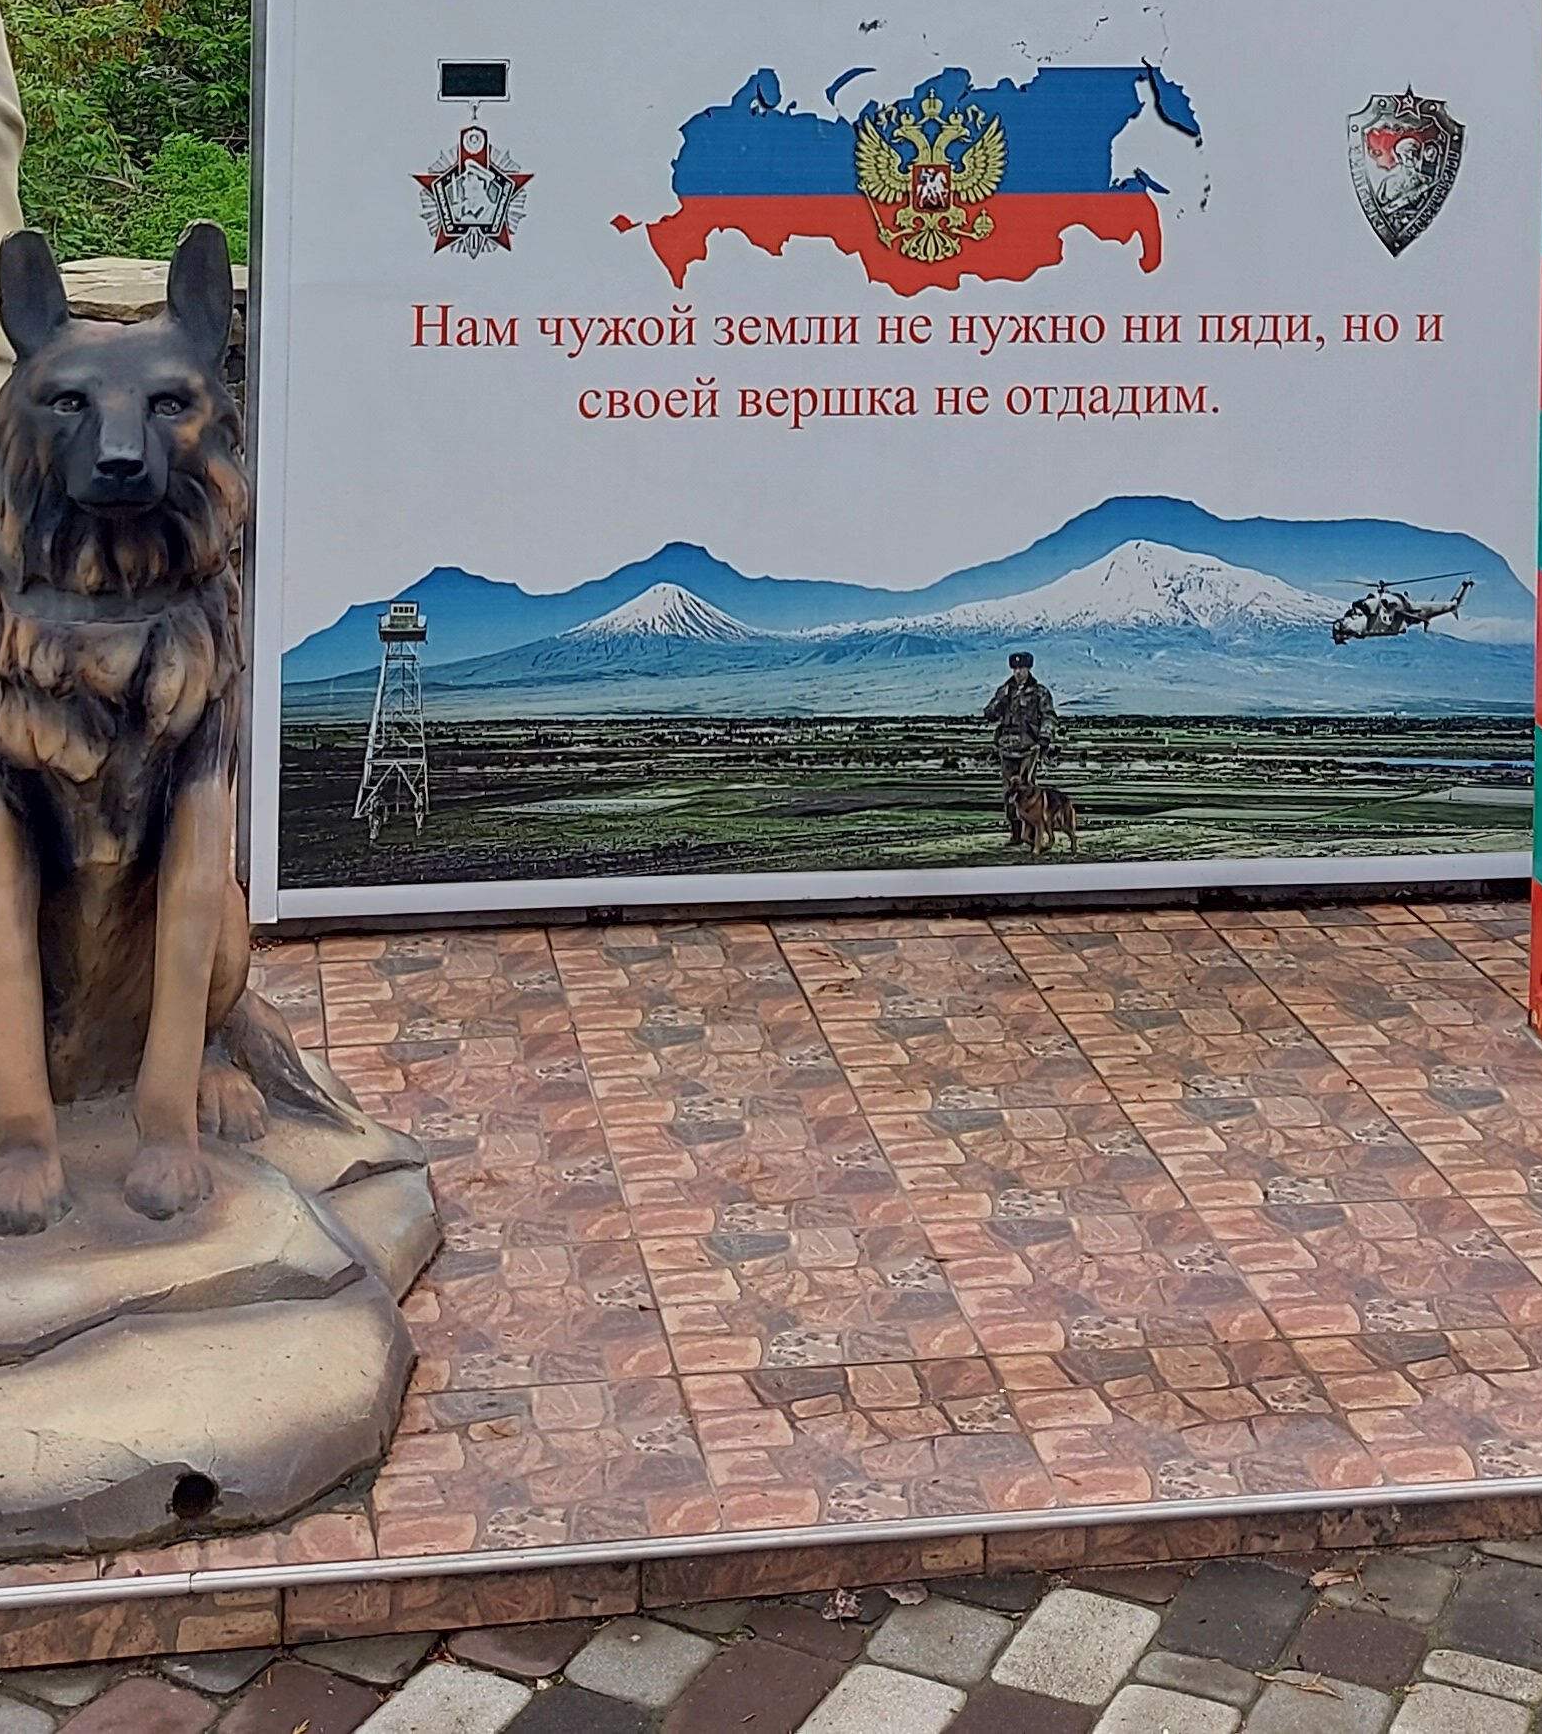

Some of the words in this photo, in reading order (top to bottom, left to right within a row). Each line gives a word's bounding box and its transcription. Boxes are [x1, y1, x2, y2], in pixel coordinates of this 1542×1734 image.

[412, 301, 520, 348] Нам
[537, 301, 697, 358] чужой
[712, 311, 860, 347] земли
[876, 311, 934, 346] не
[947, 311, 1109, 357] нужно
[1122, 311, 1181, 345] ни
[1197, 311, 1329, 356] пяди,
[1343, 311, 1400, 344] но
[1416, 311, 1446, 344] и
[577, 374, 721, 419] своей
[737, 384, 919, 430] вершка
[933, 383, 990, 416] не
[1004, 381, 1222, 424] отдадим.
